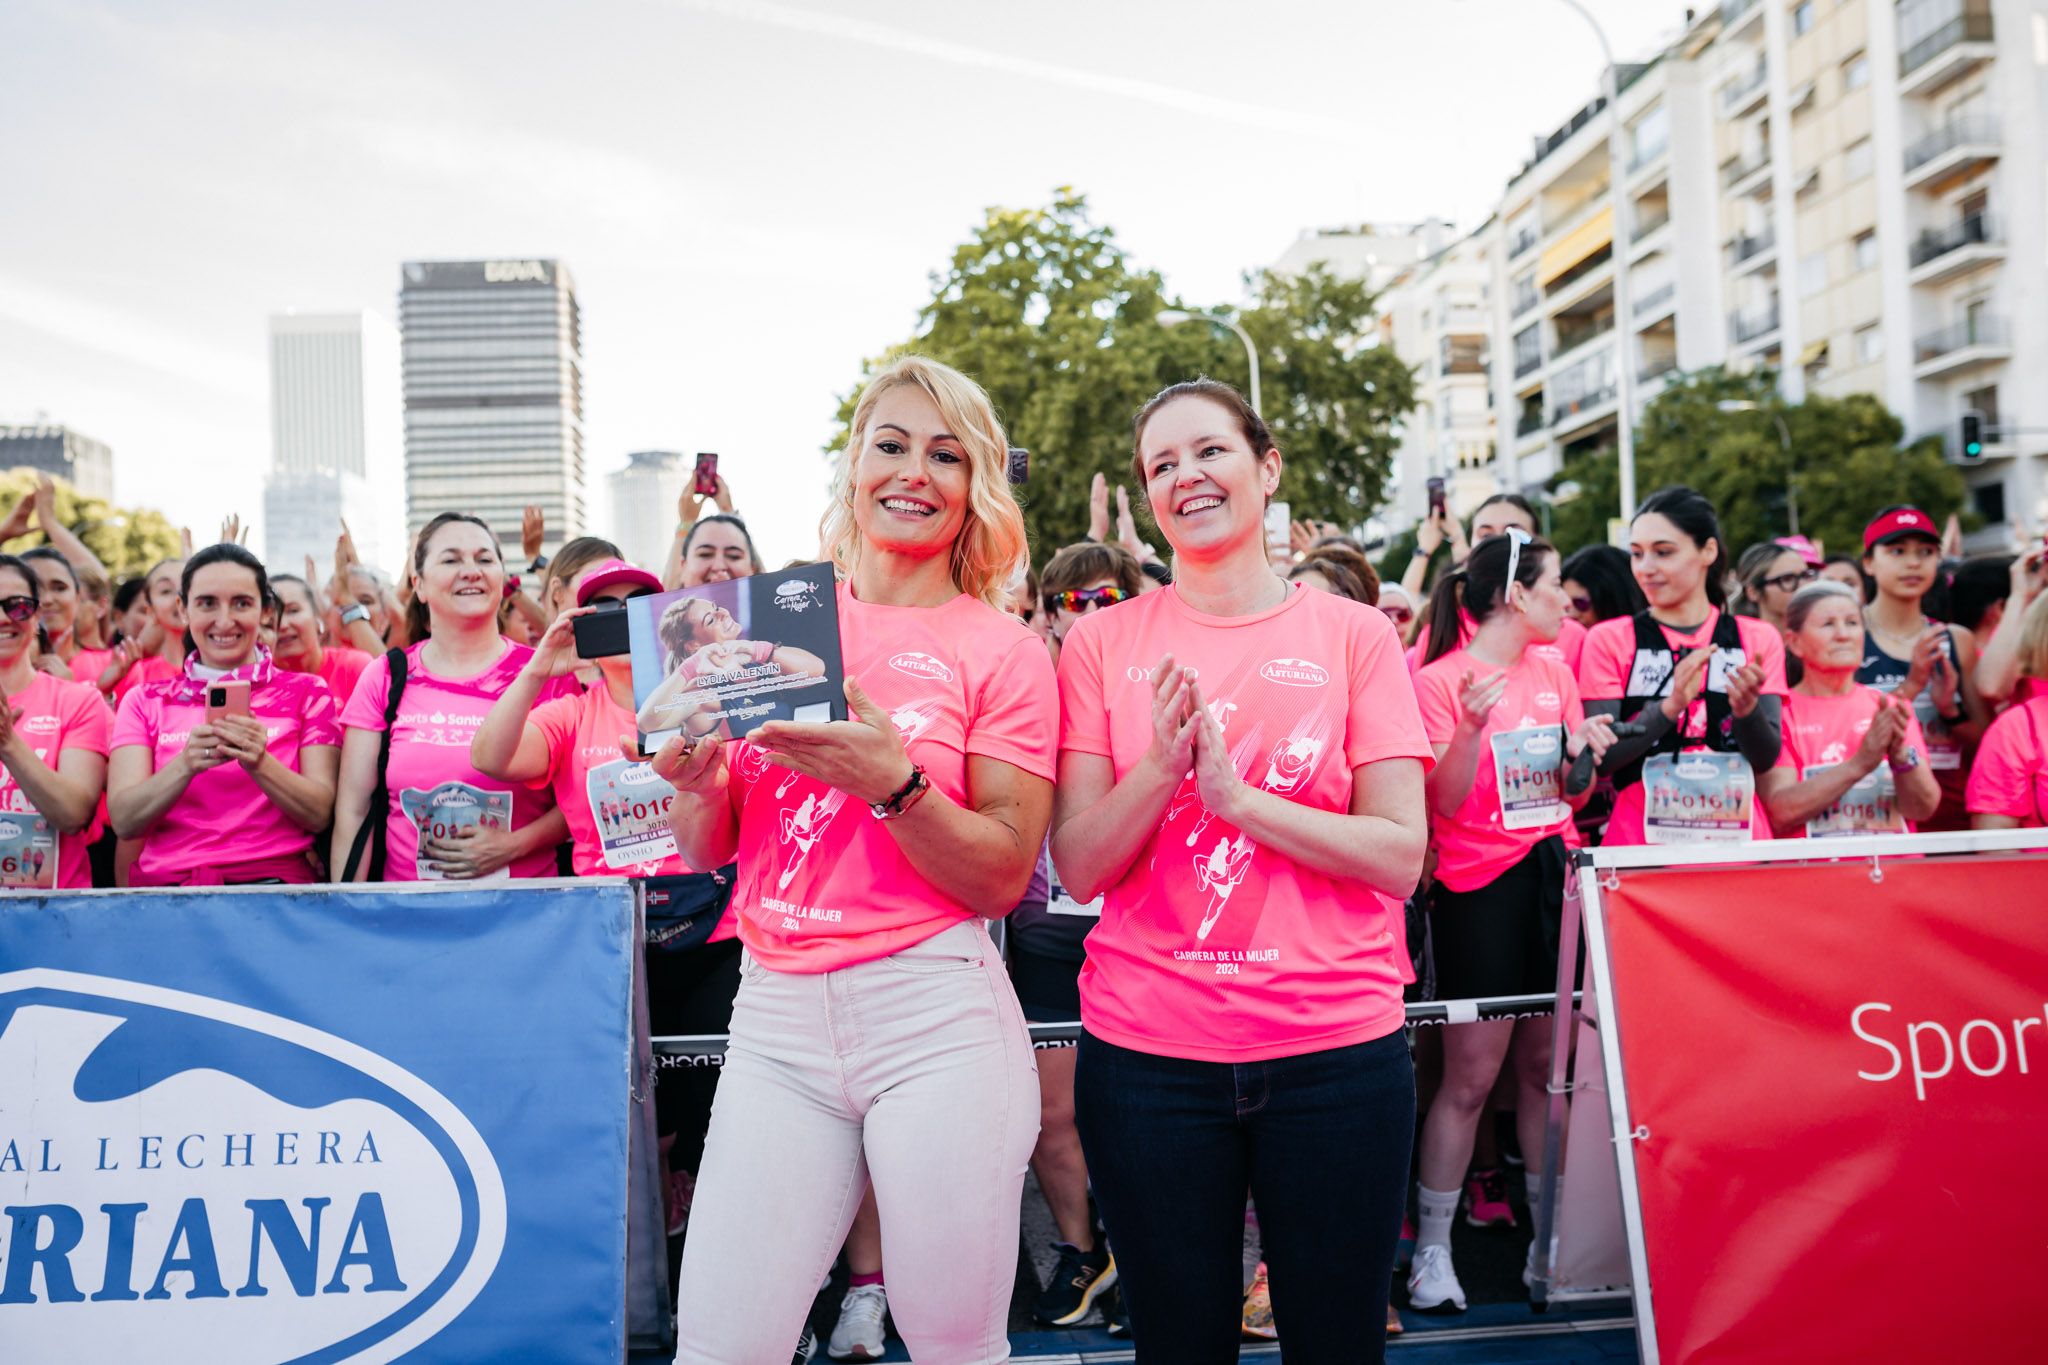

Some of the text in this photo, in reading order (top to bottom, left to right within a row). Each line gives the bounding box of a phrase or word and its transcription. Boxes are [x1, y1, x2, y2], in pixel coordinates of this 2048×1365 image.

[697, 674, 729, 687] LYDIA
[729, 661, 781, 681] VALENTÍN
[1265, 665, 1325, 683] ASTURIANA
[1682, 793, 1723, 809] 016
[761, 897, 788, 914] CARRERA
[796, 906, 807, 918] LA
[809, 907, 842, 923] MUJER
[781, 916, 800, 931] 2024
[1173, 949, 1280, 962] CARRERA DE LA MUJER
[1215, 963, 1240, 975] 2024
[0, 1130, 384, 1172] AL LECHERA
[0, 1192, 408, 1304] RIANA
